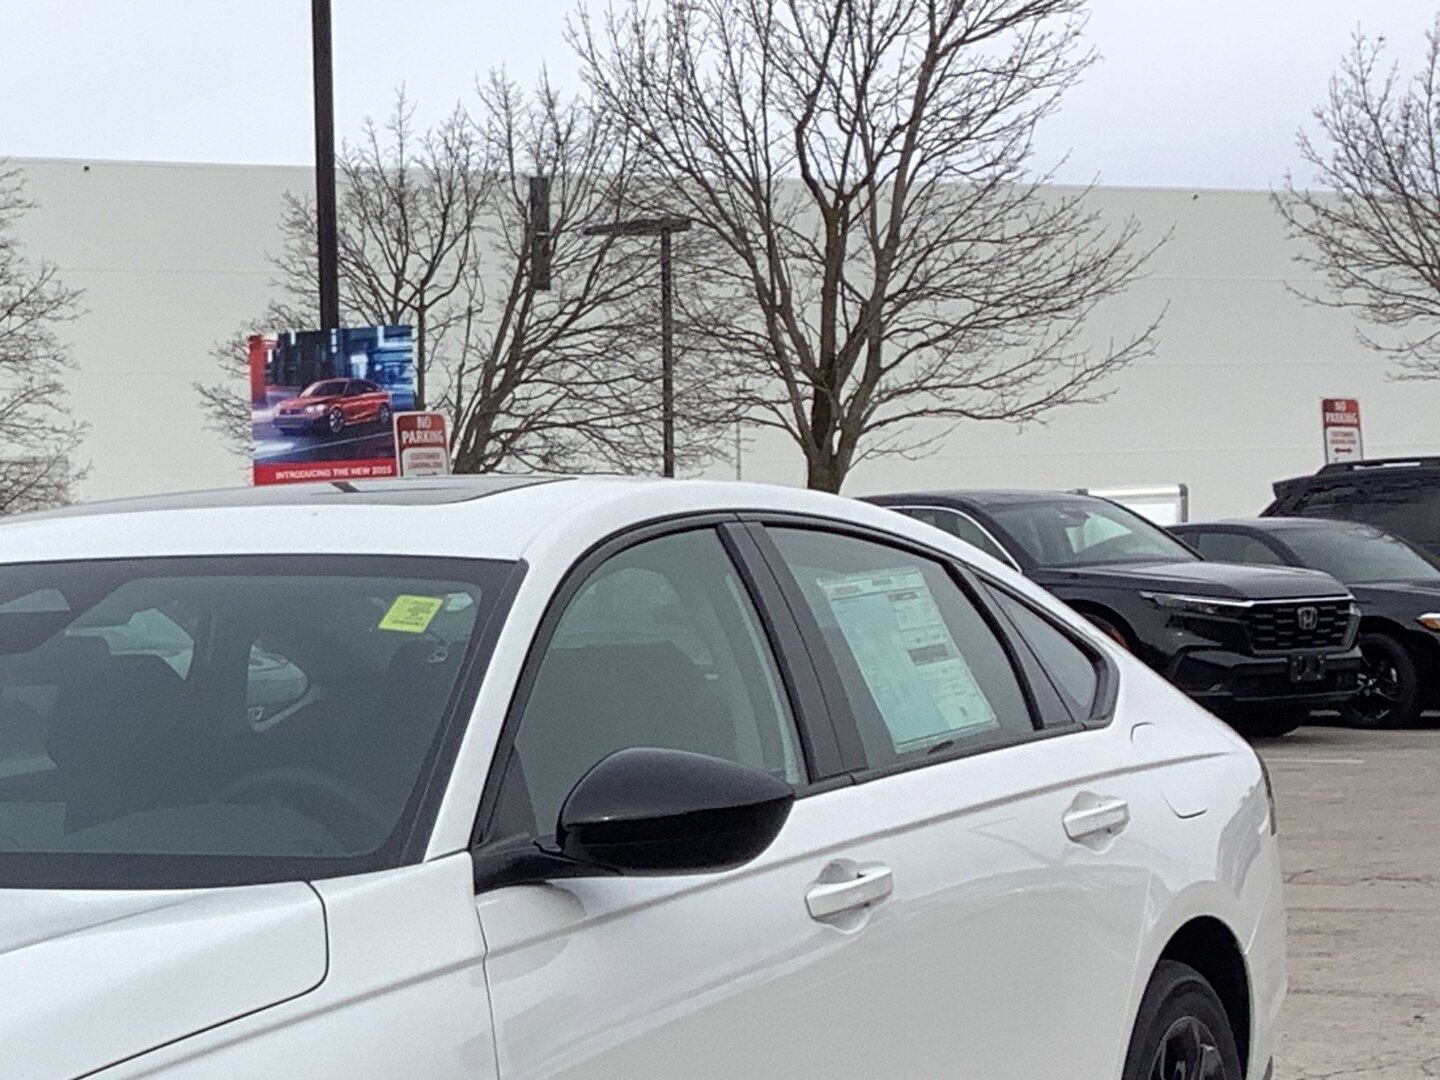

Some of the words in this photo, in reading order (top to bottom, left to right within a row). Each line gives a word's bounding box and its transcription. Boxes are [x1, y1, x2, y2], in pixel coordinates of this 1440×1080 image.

[416, 416, 432, 429] NO
[401, 430, 444, 444] PARKING
[275, 468, 331, 479] INTRODUCING
[332, 467, 349, 476] THE
[350, 466, 370, 475] NEW
